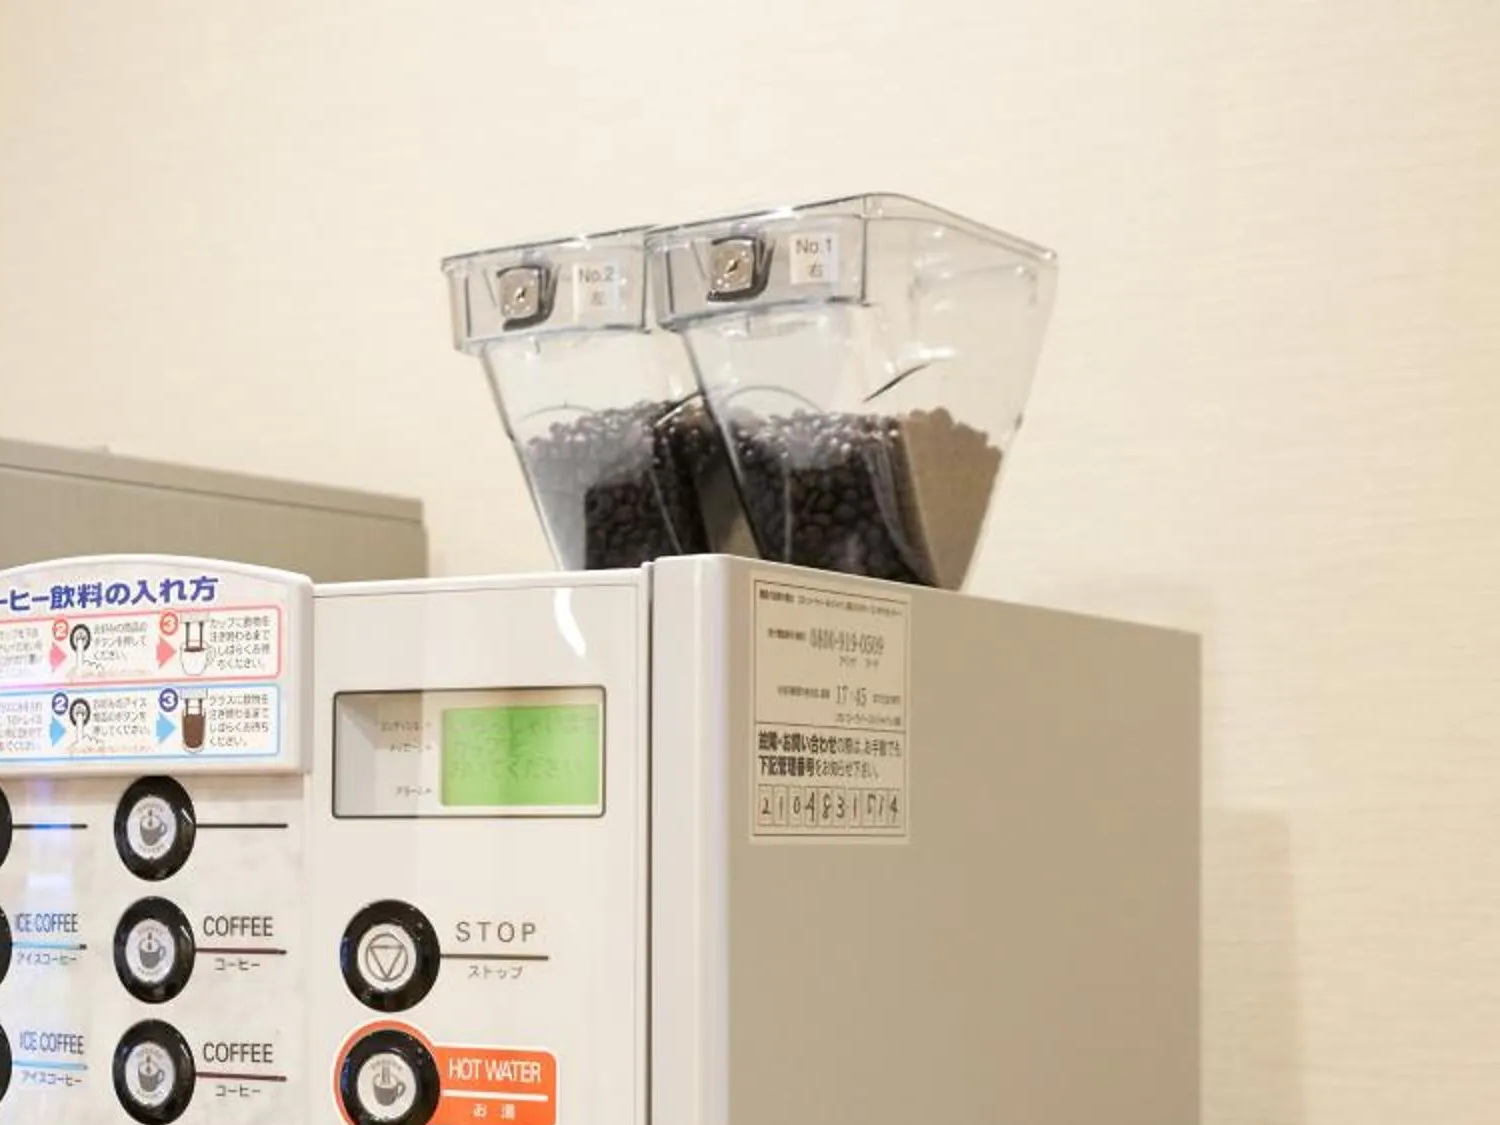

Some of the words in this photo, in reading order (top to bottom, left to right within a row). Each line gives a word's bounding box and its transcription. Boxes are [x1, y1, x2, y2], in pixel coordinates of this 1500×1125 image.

[796, 239, 833, 255] No.1
[15, 913, 31, 932] ICE
[35, 913, 79, 933] COFFEE
[203, 915, 274, 937] COFFEE
[455, 921, 537, 943] STOP
[16, 952, 77, 965] アイスコーヒー
[214, 958, 261, 971] コーヒー
[468, 965, 523, 980] ストップ
[19, 1032, 37, 1051] ICE
[39, 1032, 85, 1055] COFFEE
[203, 1042, 274, 1063] COFFEE
[21, 1070, 83, 1087] アイスコーヒー
[449, 1057, 482, 1081] HOT
[484, 1059, 541, 1084] WATER
[215, 1084, 261, 1097] コーヒー
